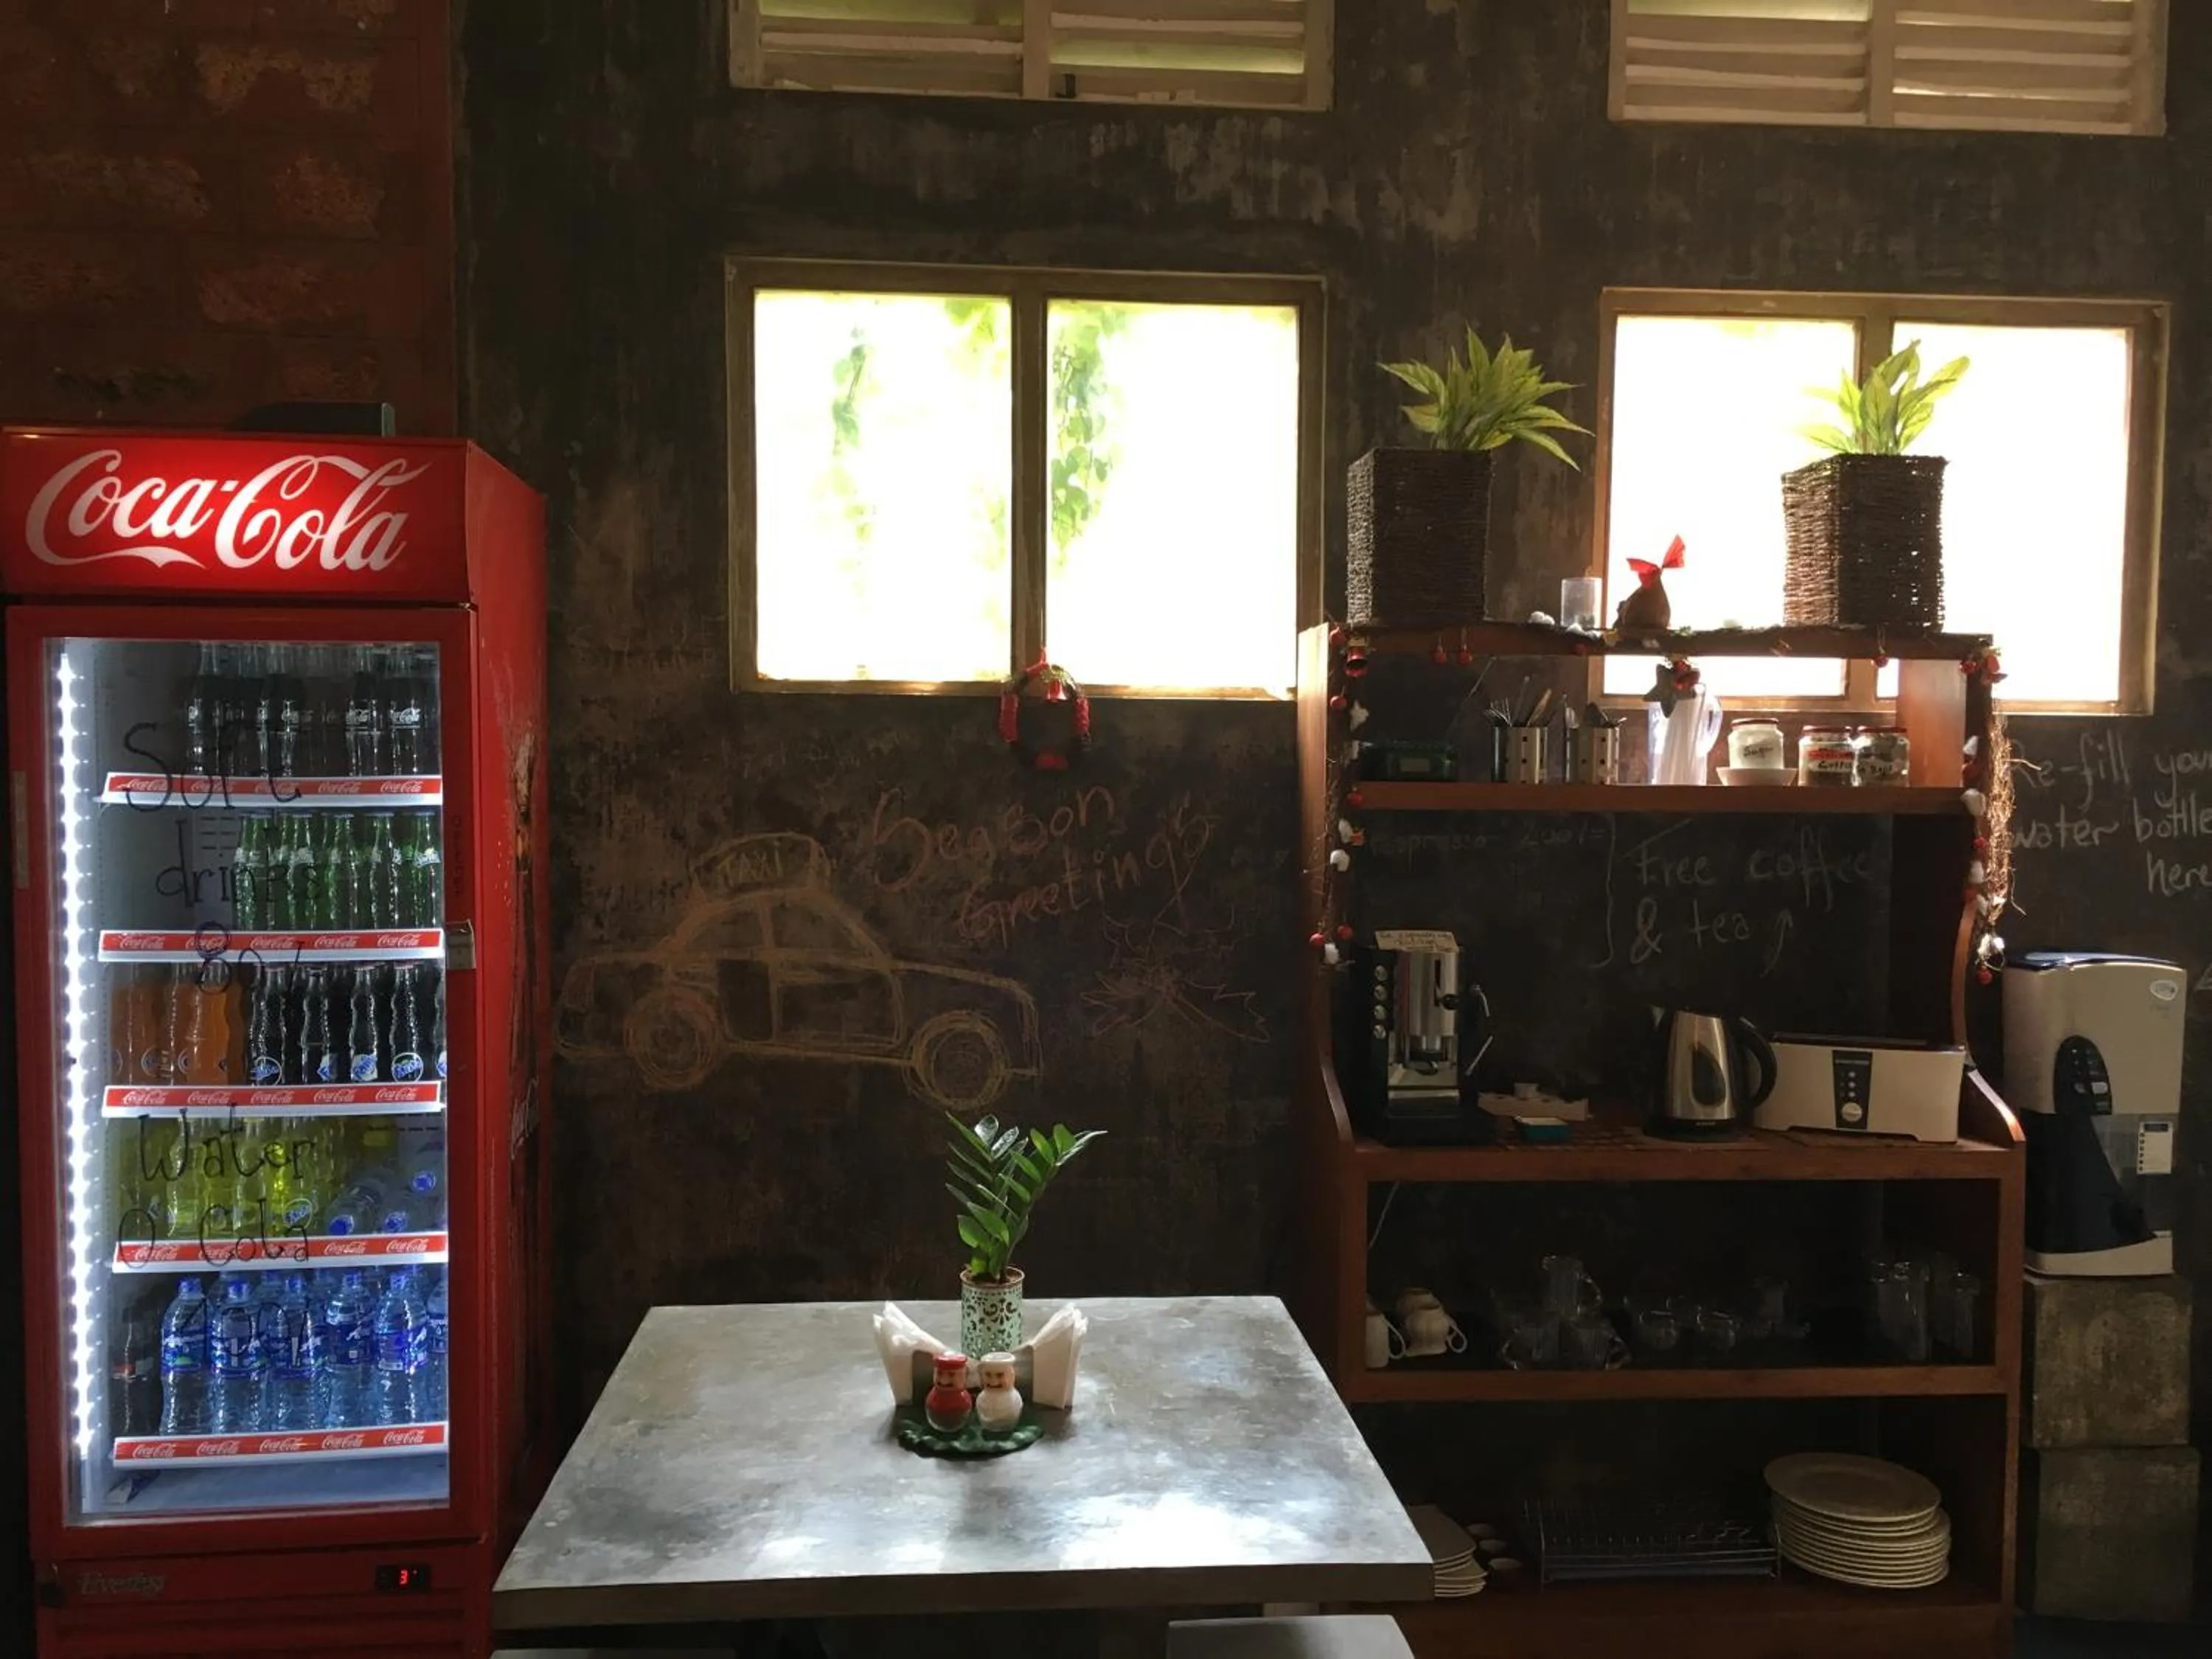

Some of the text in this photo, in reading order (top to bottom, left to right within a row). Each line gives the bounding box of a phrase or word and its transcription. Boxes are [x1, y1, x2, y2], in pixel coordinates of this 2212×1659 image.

[25, 448, 434, 571] Coca-Cola
[2012, 804, 2120, 849] water
[1630, 896, 1751, 964] & tea
